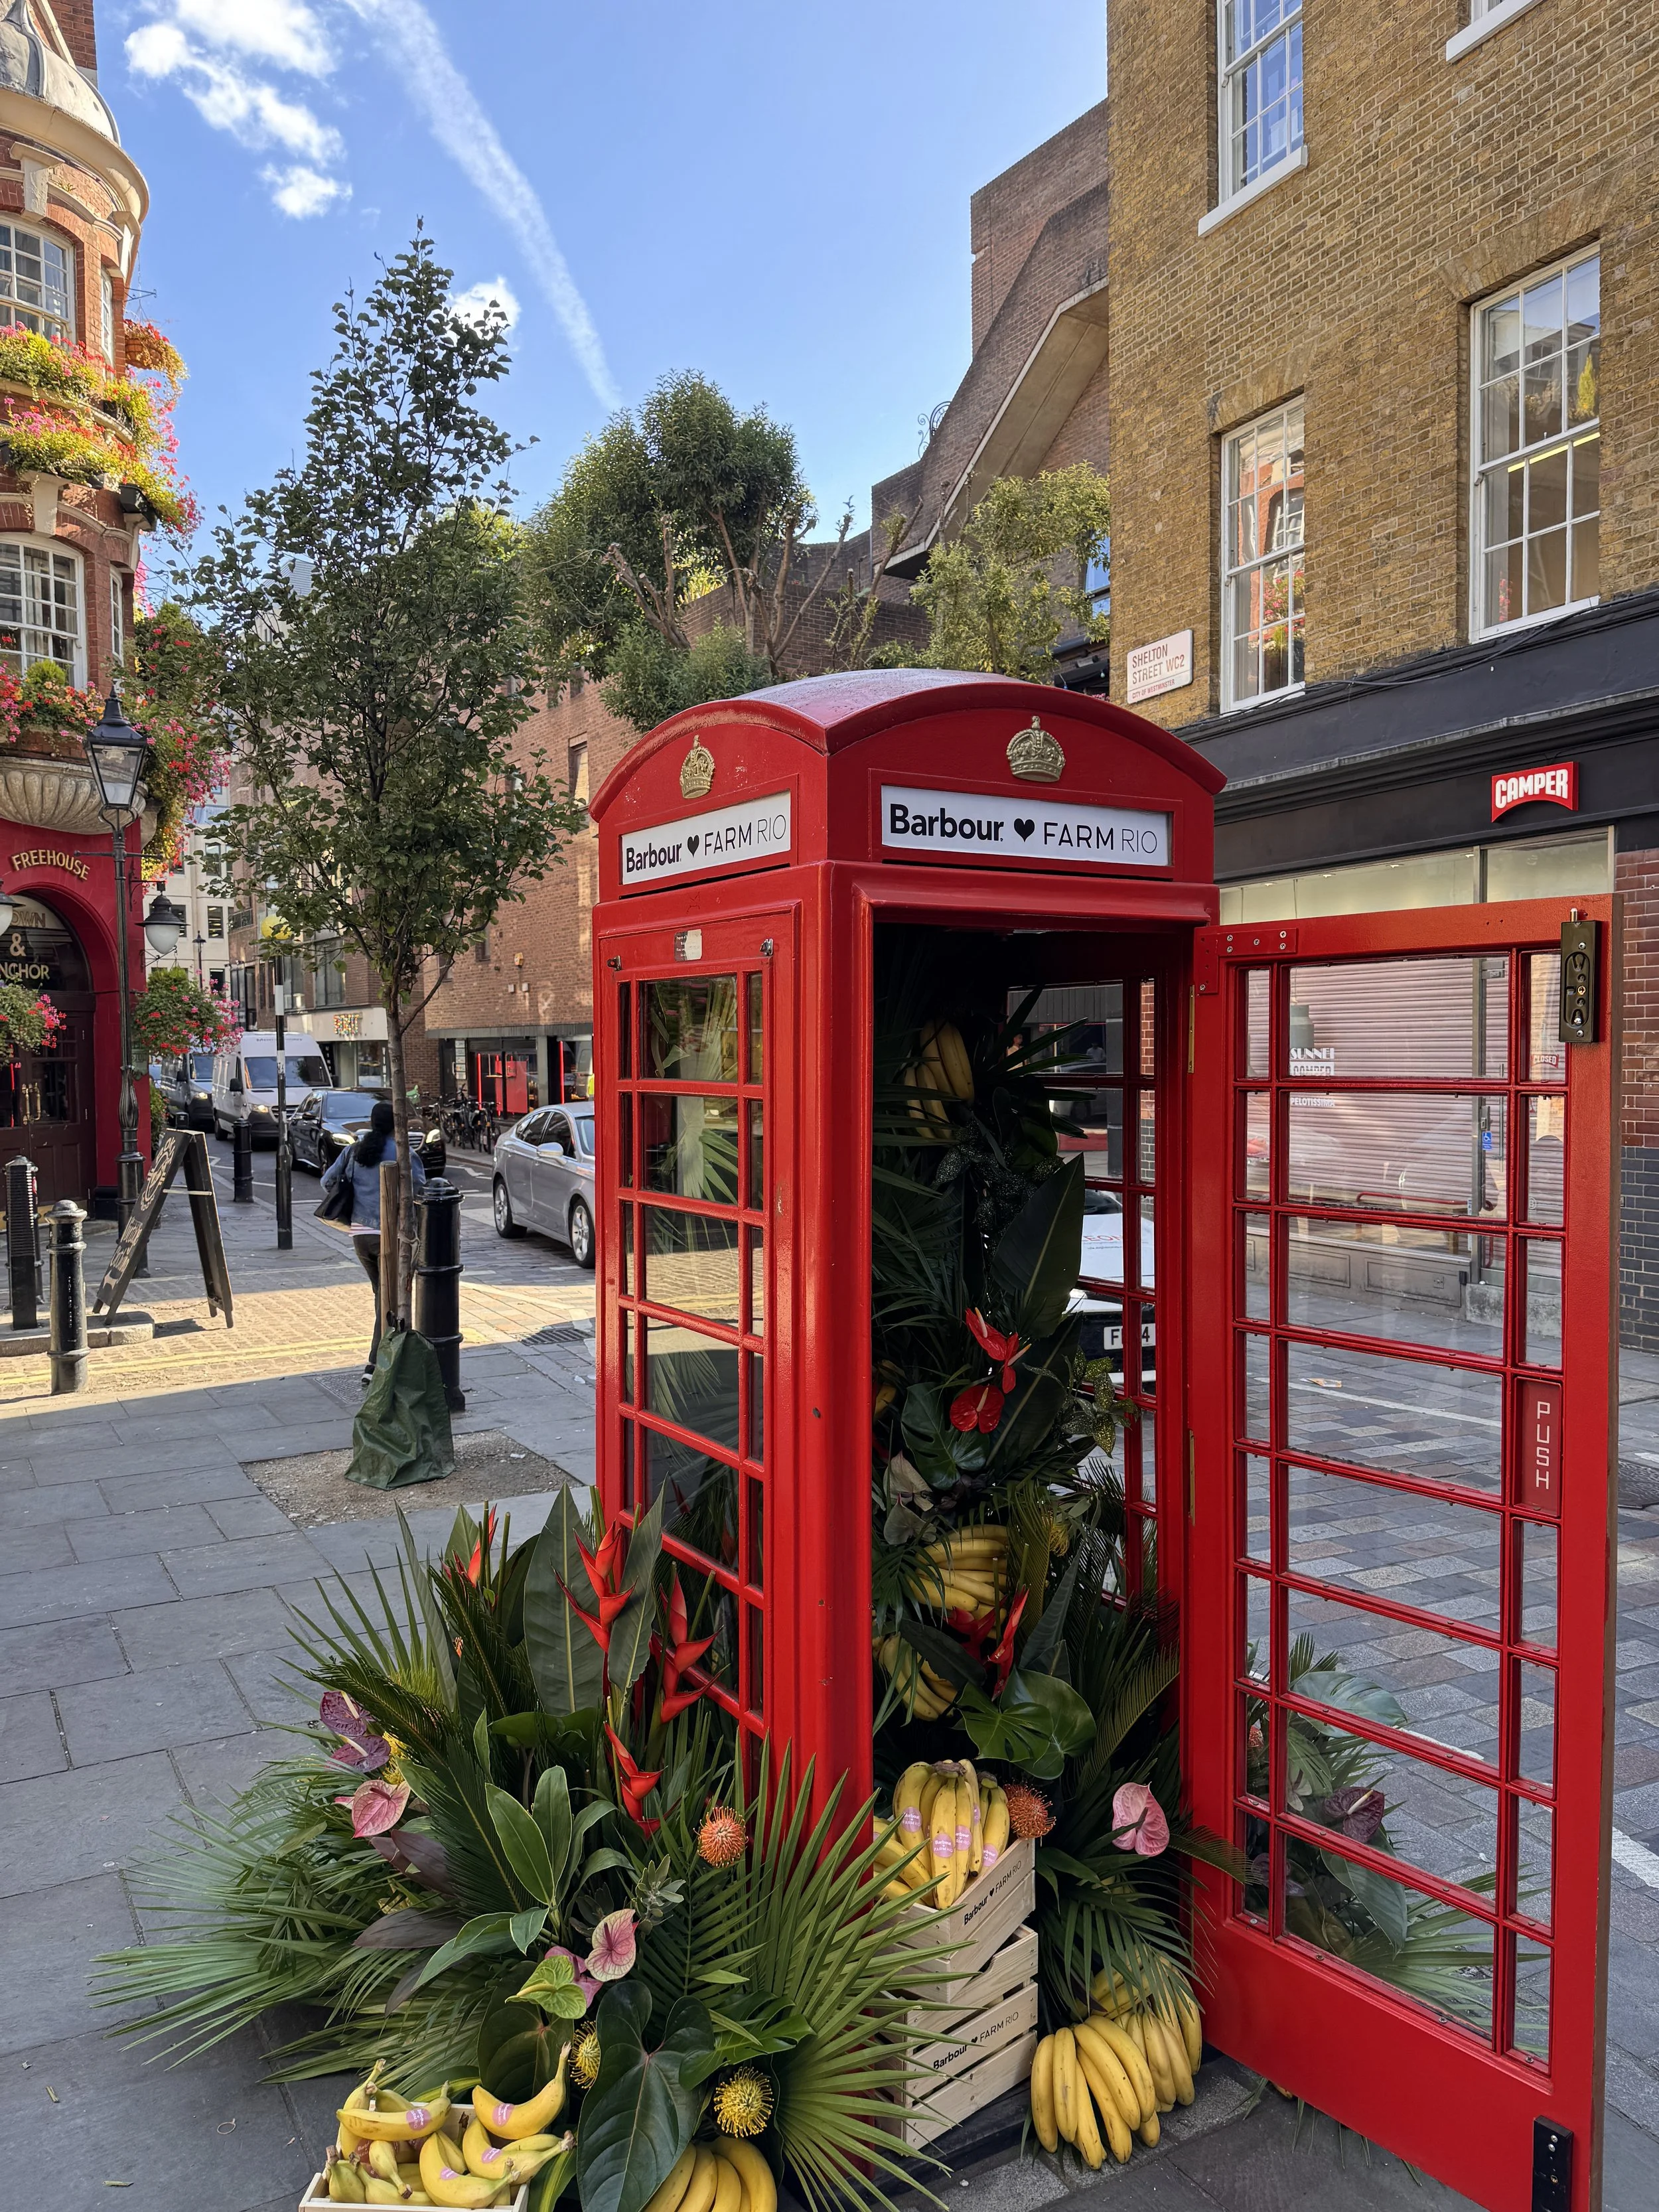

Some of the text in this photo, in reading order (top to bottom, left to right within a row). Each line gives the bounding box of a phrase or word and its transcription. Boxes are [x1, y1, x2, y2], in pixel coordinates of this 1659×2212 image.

[1132, 644, 1168, 668] SHELTON
[1132, 654, 1185, 684] STREET WC2
[1147, 679, 1175, 694] WESTMINSTER
[1495, 769, 1568, 808] CAMPER
[890, 803, 1157, 853] Barbour FARM RIO
[626, 814, 786, 873] Barbour FARM RIO
[11, 849, 90, 881] FREEHOUSE
[9, 932, 27, 956] &
[0, 962, 50, 980] NCHOR
[1290, 1048, 1334, 1059] SUNNEI
[1533, 1055, 1556, 1065] CLOSED
[1290, 1097, 1335, 1107] PELOTISSIMA
[1536, 1401, 1550, 1489] PUSH
[964, 1860, 1021, 1926] Barbour FARM RIO
[933, 2012, 1019, 2070] Barbour FARM RIO
